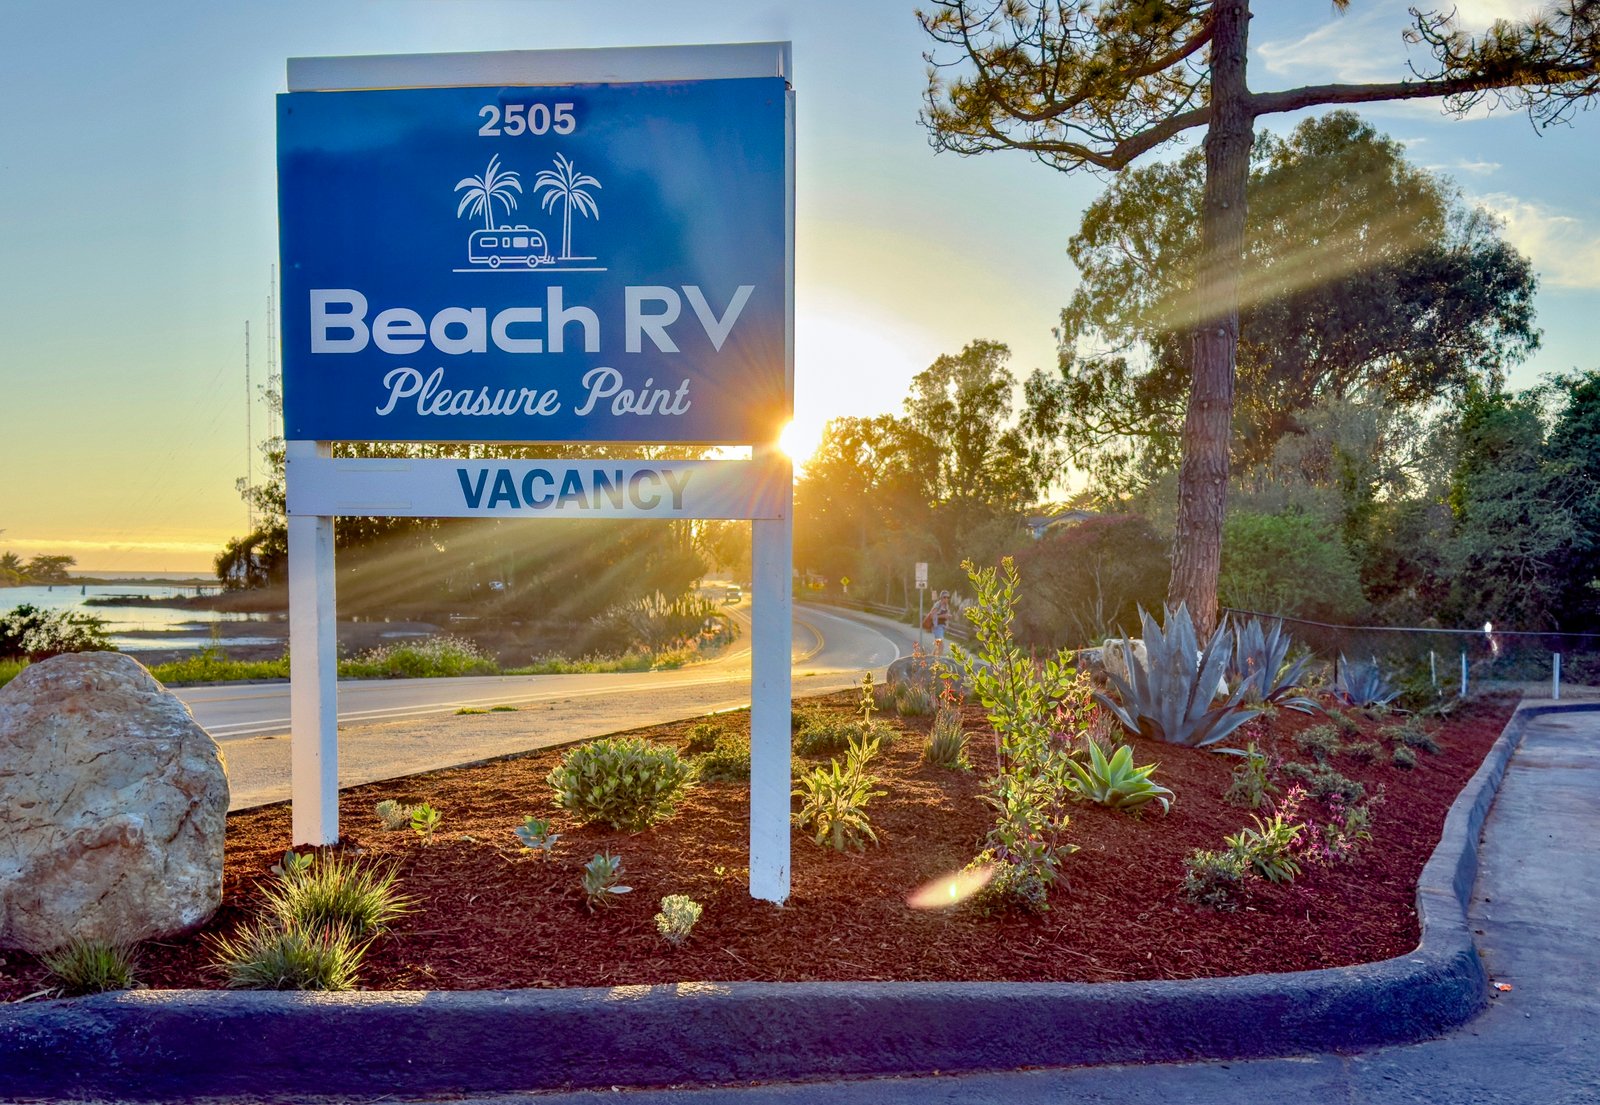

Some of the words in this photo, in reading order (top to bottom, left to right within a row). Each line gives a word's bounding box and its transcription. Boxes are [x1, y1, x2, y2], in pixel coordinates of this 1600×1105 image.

[478, 103, 577, 137] 2505
[309, 286, 600, 355] Beach
[624, 285, 756, 354] RV
[375, 367, 562, 417] Pleasure
[575, 367, 692, 417] Point
[457, 468, 694, 510] VACANCY
